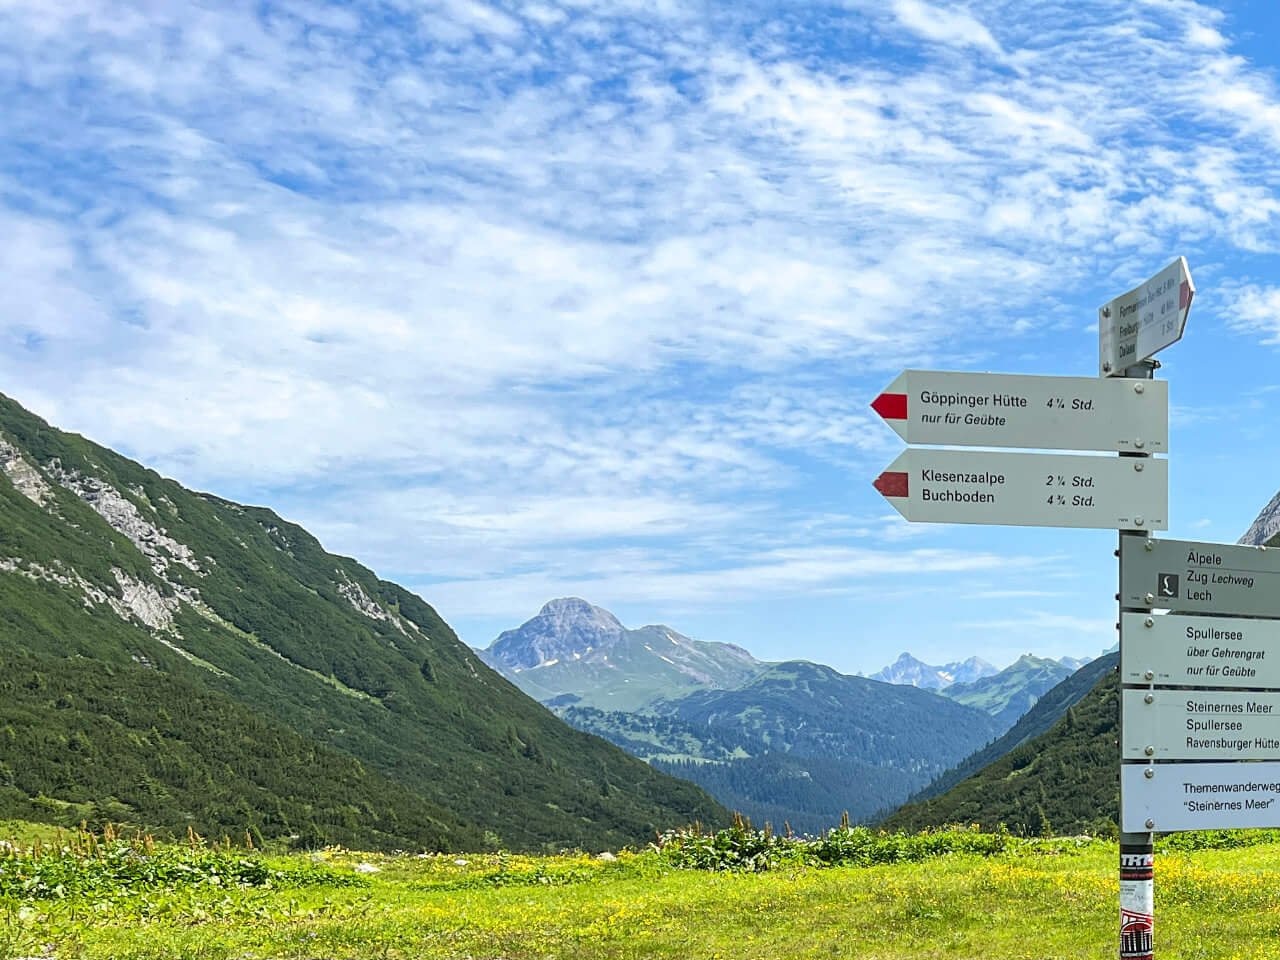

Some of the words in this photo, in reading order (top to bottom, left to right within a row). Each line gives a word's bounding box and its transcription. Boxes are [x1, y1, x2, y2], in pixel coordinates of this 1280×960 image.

[920, 390, 990, 408] Göppinger
[993, 393, 1027, 408] Hütte
[1071, 398, 1095, 411] Std.
[921, 414, 942, 424] nur
[944, 412, 962, 425] für
[964, 413, 1006, 426] Geübte
[921, 469, 1005, 486] Klesenzaalpe
[1071, 475, 1095, 488] Std.
[922, 488, 995, 503] Buchboden
[1071, 495, 1095, 507] Std.
[1186, 569, 1208, 586] Zug
[1211, 572, 1254, 589] Lechweg
[1187, 588, 1212, 601] Lech
[1186, 626, 1243, 641] Spullersee
[1186, 646, 1210, 658] über
[1211, 647, 1265, 661] Gehrengrat
[1186, 666, 1204, 676] nur
[1205, 664, 1221, 676] für
[1221, 665, 1256, 678] Geübte
[1186, 700, 1244, 713] Steinernes
[1246, 701, 1273, 714] Meer
[1186, 718, 1243, 732] Spullersee
[1186, 736, 1253, 752] Ravensburger
[1254, 737, 1280, 749] Hütte
